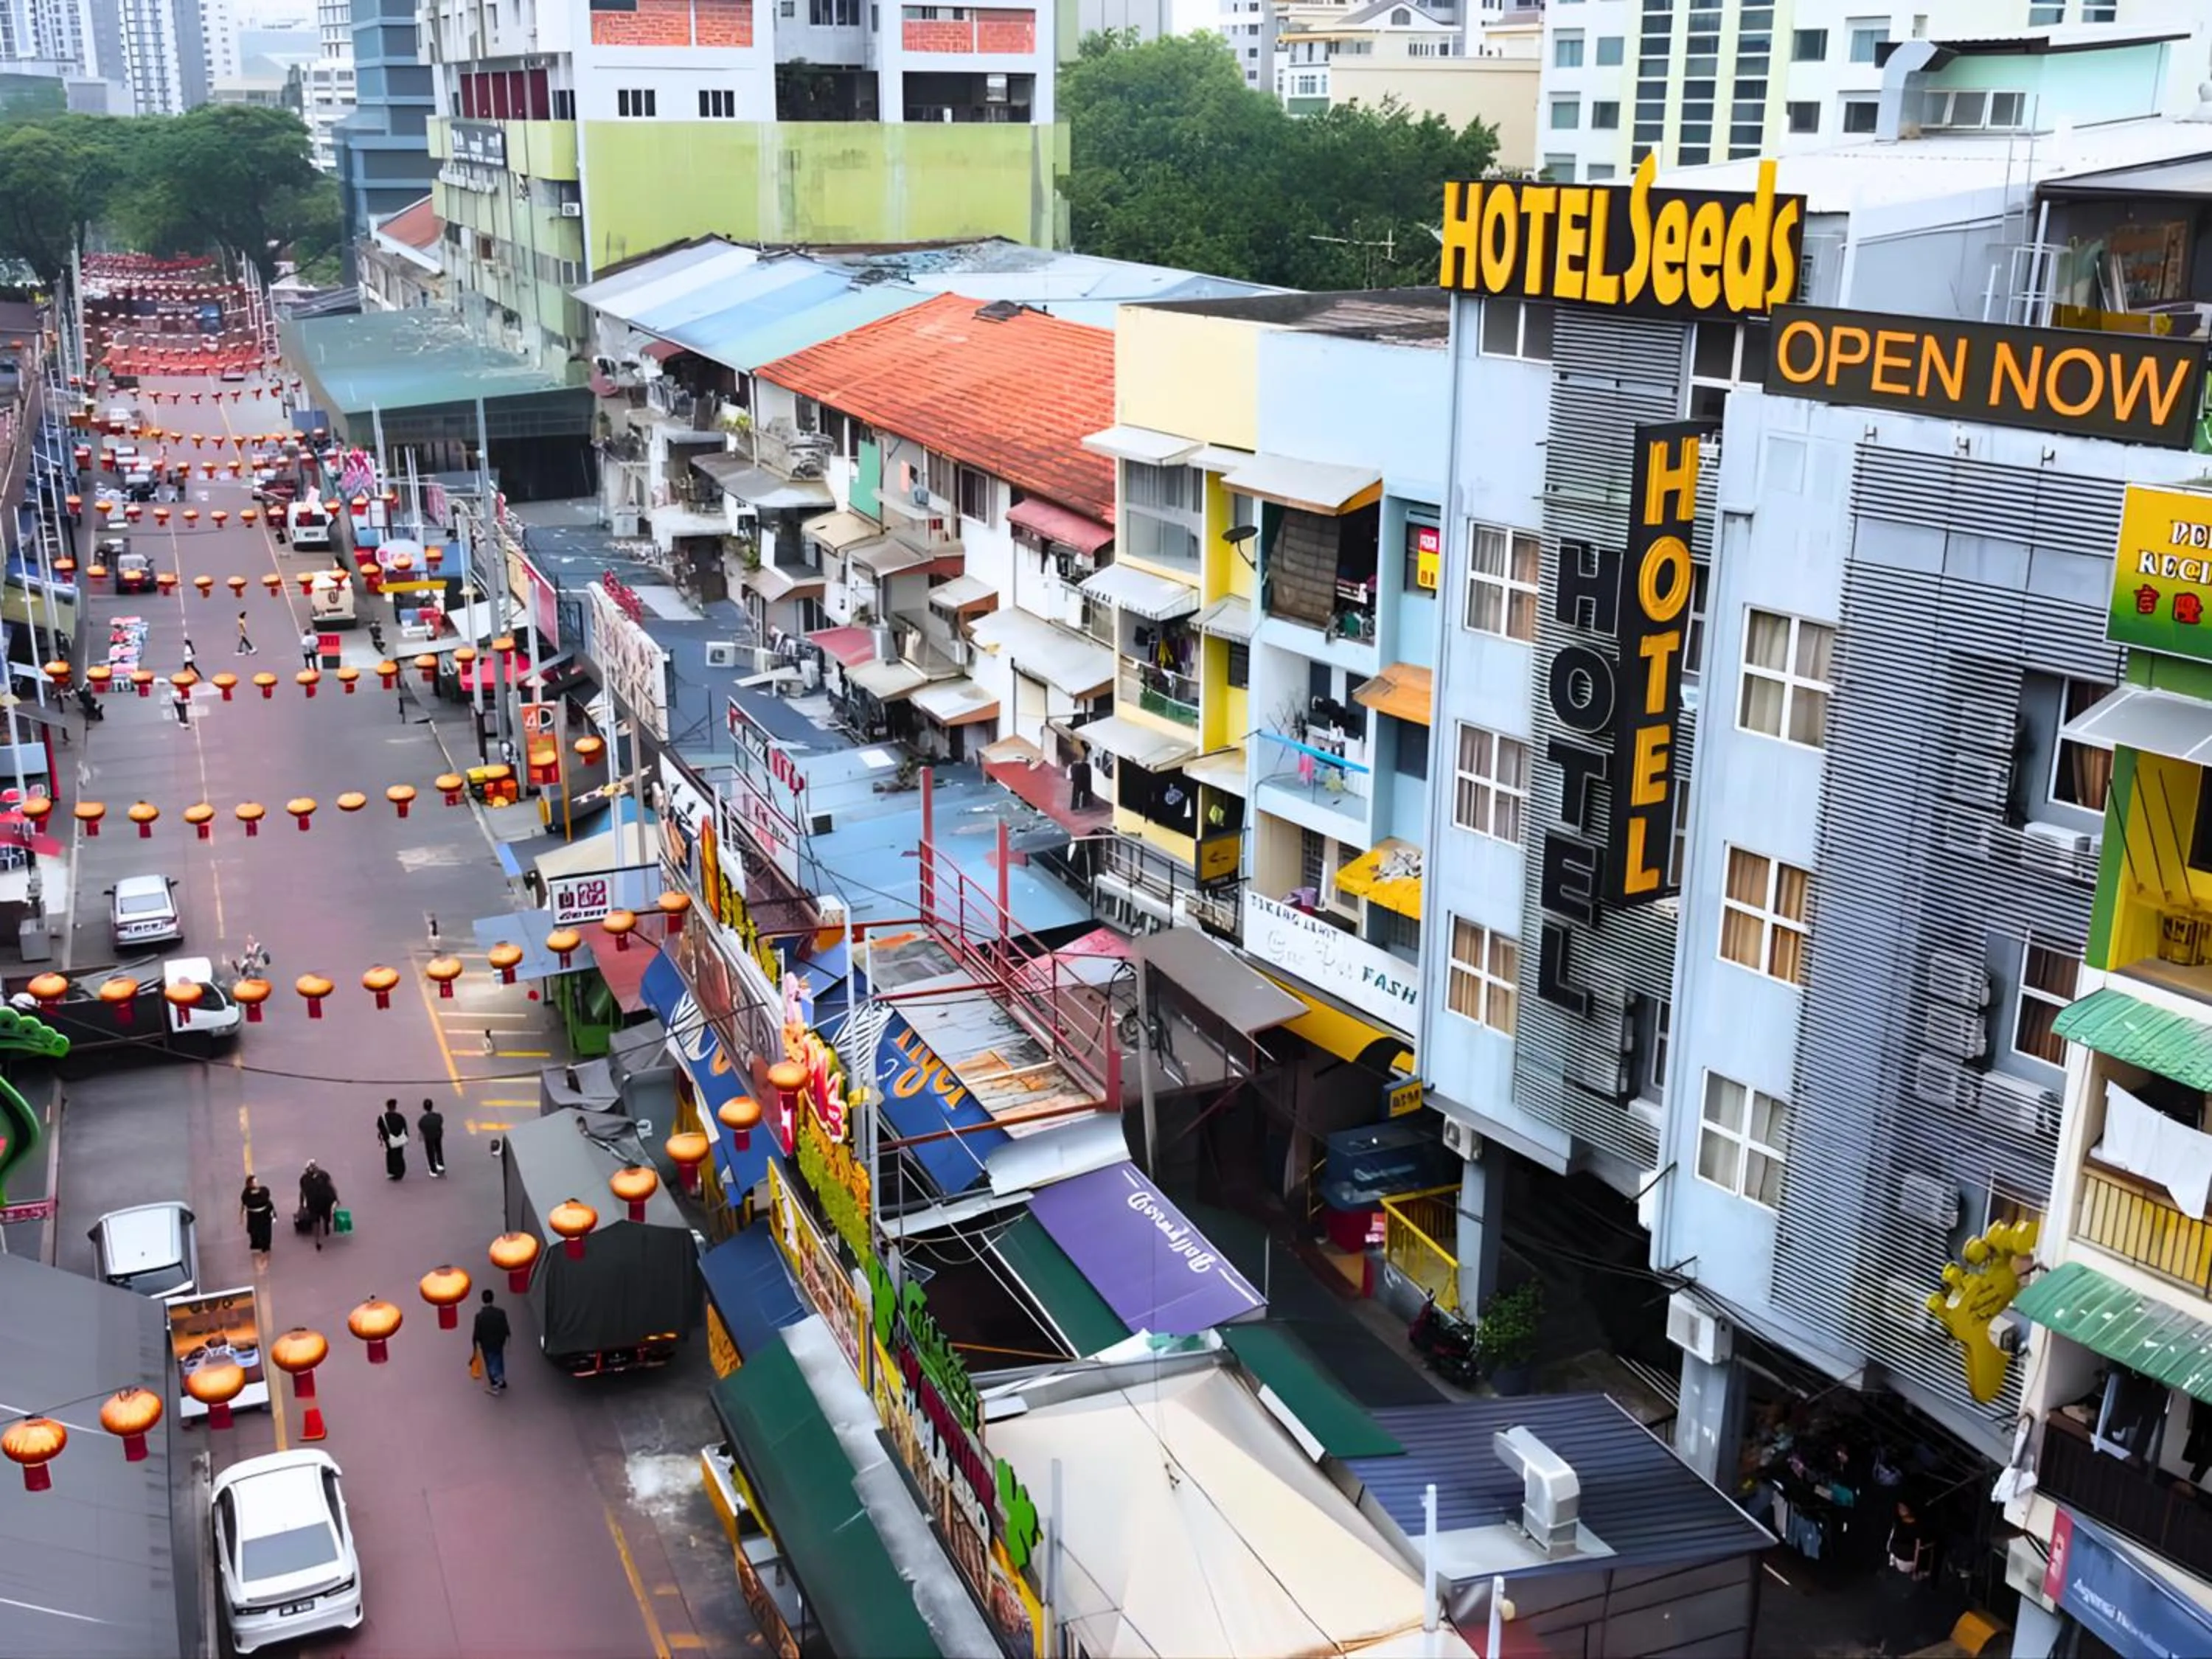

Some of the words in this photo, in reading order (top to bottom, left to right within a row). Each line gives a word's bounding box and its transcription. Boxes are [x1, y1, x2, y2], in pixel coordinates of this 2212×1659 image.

[1440, 181, 1618, 305] HOTEL
[1624, 153, 1799, 312] Seeds
[1776, 320, 1967, 401] OPEN
[1988, 341, 2190, 426] NOW
[1540, 543, 1622, 1016] HOTEL
[1624, 436, 1699, 894] HOTEL
